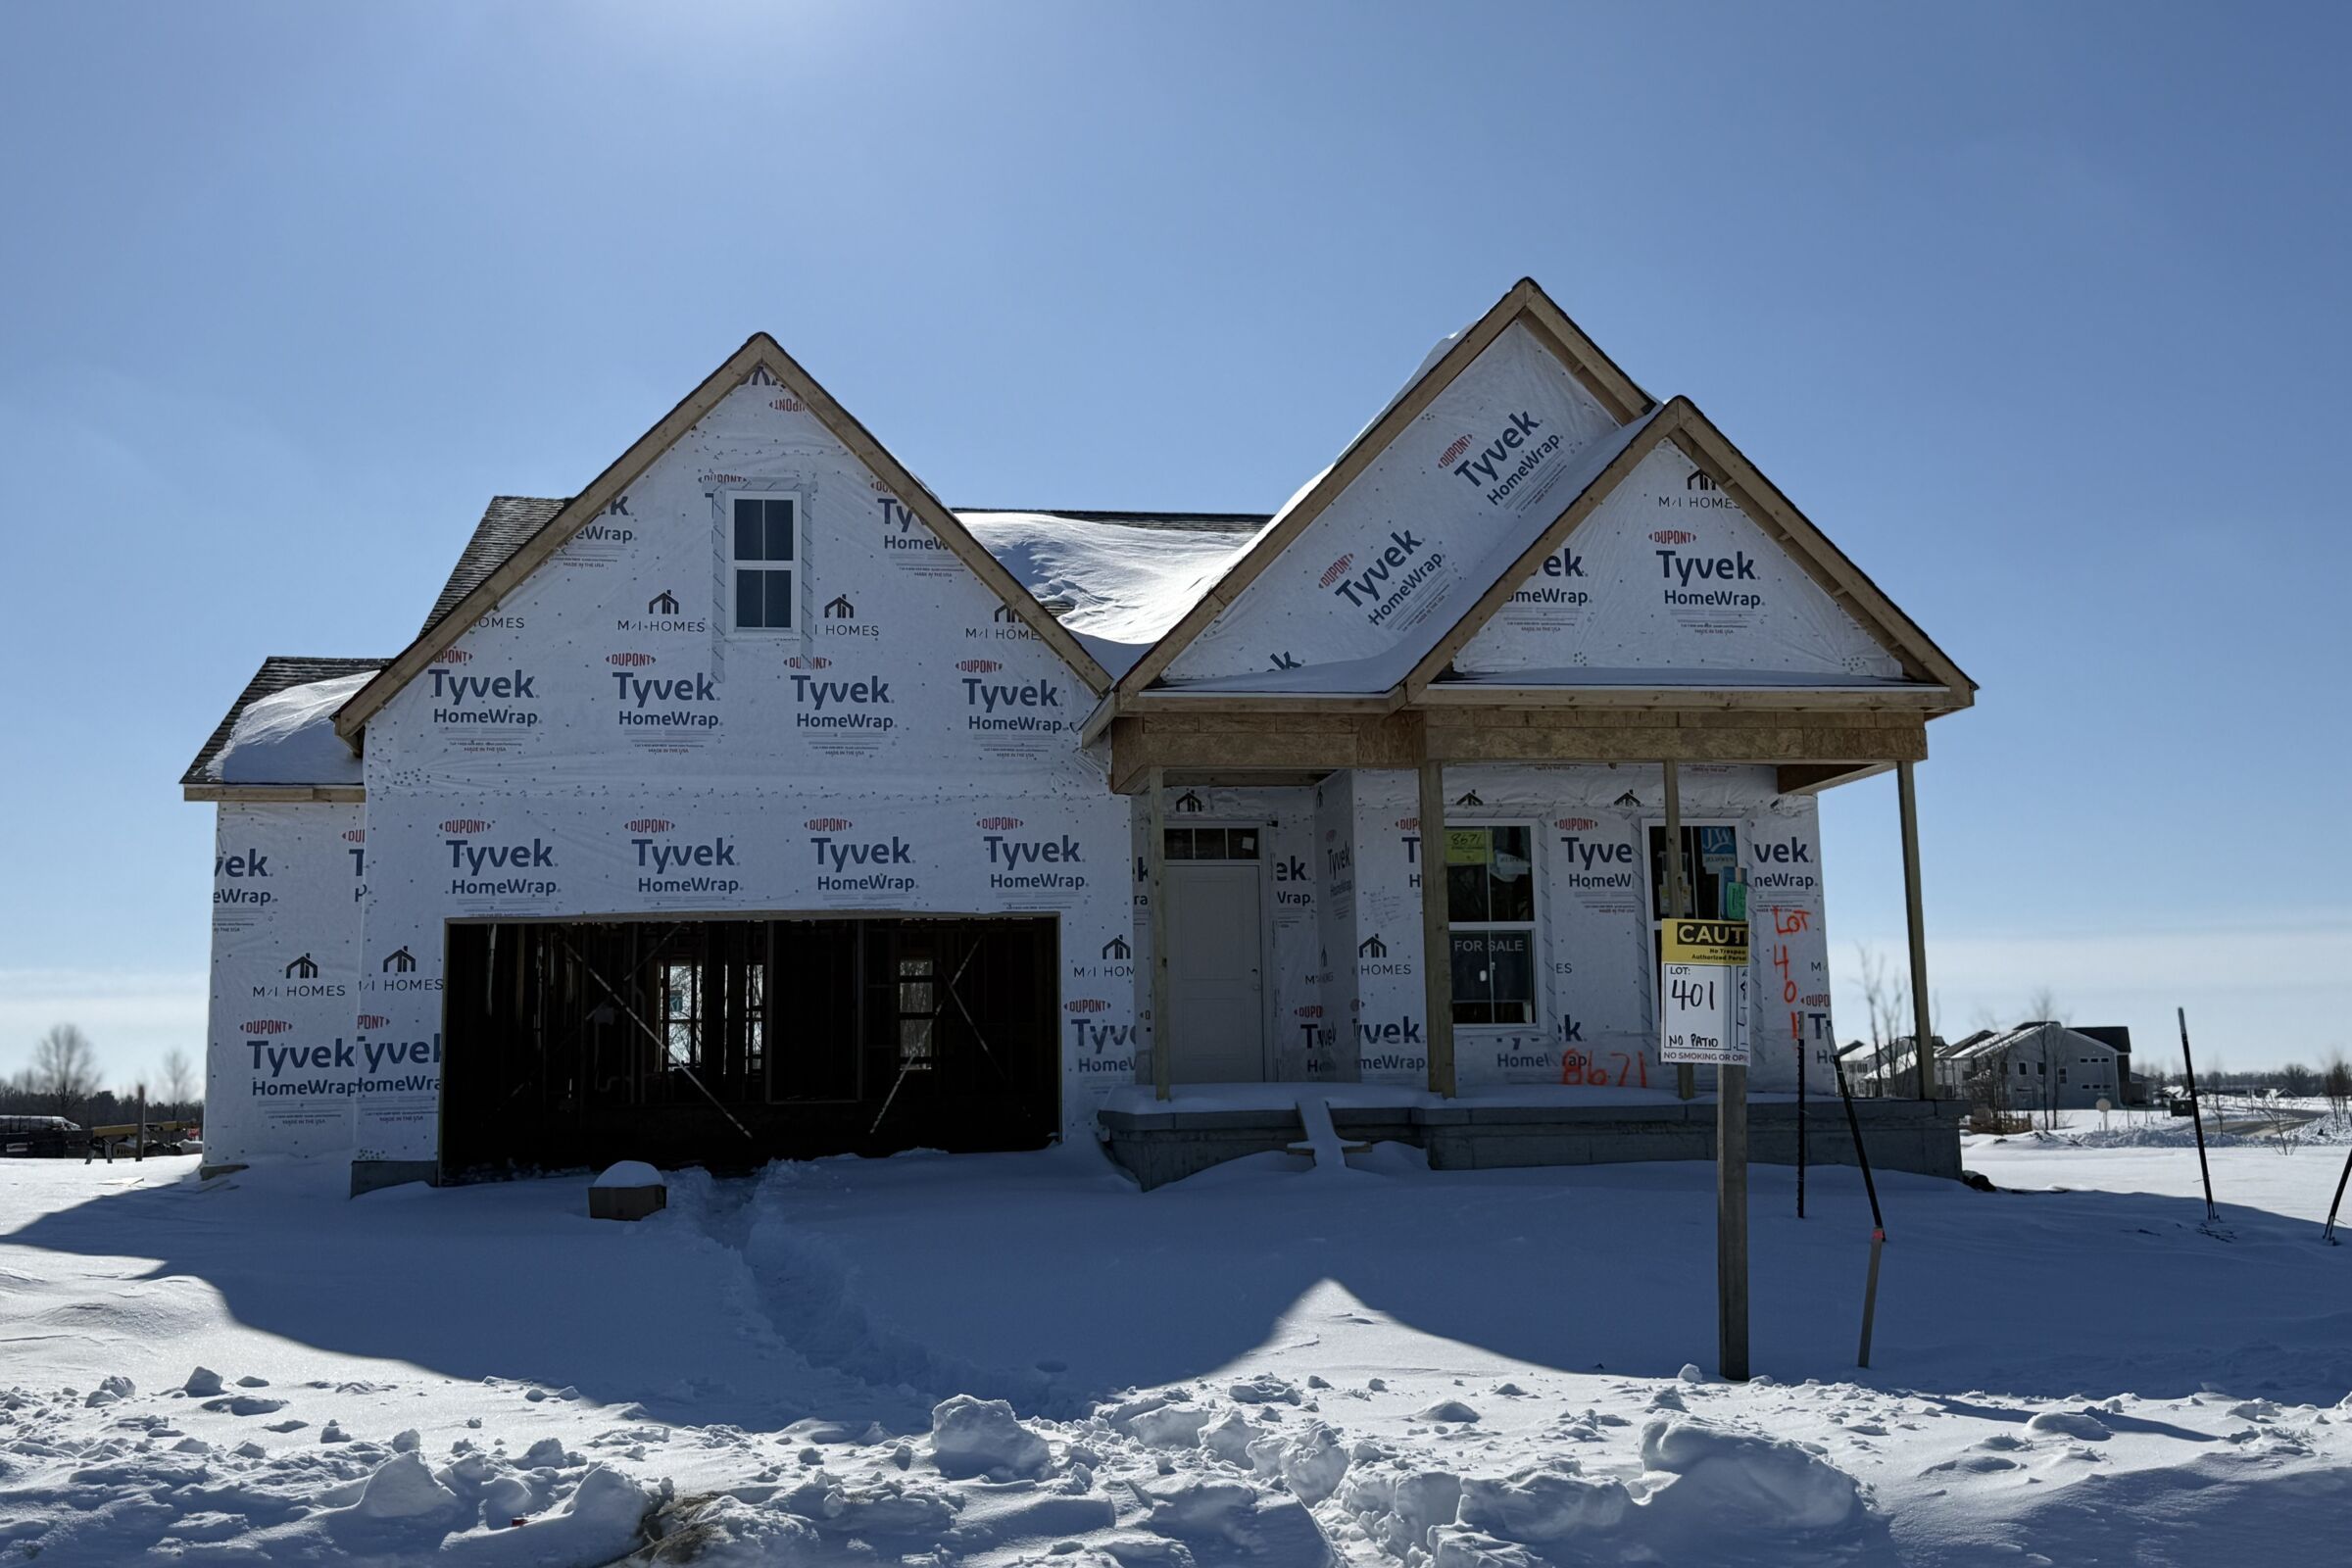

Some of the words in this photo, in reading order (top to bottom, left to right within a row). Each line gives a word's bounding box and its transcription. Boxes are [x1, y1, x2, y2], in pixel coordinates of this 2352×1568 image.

[1441, 436, 1470, 466] DUPONT
[1454, 412, 1540, 487] Tyvek
[1487, 435, 1558, 506] HomeWrap
[1654, 531, 1691, 544] DUPONT
[1321, 555, 1351, 587] DUPONT
[1335, 530, 1422, 608] Tyvek
[1656, 551, 1756, 587] Tyvek
[1368, 553, 1442, 625] HomeWrap
[1507, 588, 1588, 606] meWrap
[1665, 590, 1760, 609] HomeWrap
[651, 621, 706, 632] HOMES
[826, 625, 879, 636] HOMES
[996, 629, 1042, 640] HOME
[612, 653, 651, 666] DUPONT
[961, 661, 998, 672] DUPONT
[428, 669, 534, 705] Tyvek
[612, 672, 715, 708] Tyvek
[790, 675, 889, 710] Tyvek
[962, 678, 1058, 713] Tyvek
[434, 709, 537, 727] HomeWrap
[619, 711, 718, 729] HomeWrap
[798, 713, 894, 731] HomeWrap
[969, 715, 1062, 733] HomeWrap
[445, 819, 485, 833] DUPONT
[631, 819, 670, 833] DUPONT
[809, 818, 848, 831] DUPONT
[982, 817, 1019, 830] DUPONT
[1560, 817, 1593, 831] DUPONT
[446, 839, 553, 876] Tyvek
[631, 837, 735, 874] Tyvek
[811, 837, 910, 872] Tyvek
[984, 835, 1080, 870] Tyvek
[1561, 837, 1632, 870] Tyve
[1754, 837, 1809, 862] vek
[452, 879, 557, 896] HomeWrap
[639, 878, 738, 894] HomeWrap
[817, 874, 915, 892] HomeWrap
[991, 873, 1084, 890] HomeWrap
[1569, 873, 1631, 888] HomeW
[1773, 906, 1811, 933] LOT
[1679, 925, 1747, 945] CAUT
[1454, 940, 1483, 953] FOR
[1488, 940, 1525, 953] SALE
[1104, 966, 1135, 978] HOM
[1360, 964, 1411, 975] HOMES
[1670, 966, 1690, 975] LOT:
[287, 985, 345, 997] HOMES
[384, 978, 443, 991] HOMES
[1672, 979, 1714, 1010] 401
[1806, 994, 1831, 1007] DUPO
[1070, 1000, 1105, 1013] DUPONT
[246, 1020, 287, 1035] DUPONT
[357, 1015, 384, 1029] PONT
[1669, 1035, 1684, 1047] NO
[1691, 1033, 1718, 1047] PATIO
[247, 1039, 355, 1077] Tyvek
[1360, 1054, 1425, 1072] meWrap
[1561, 1048, 1647, 1088] 8671
